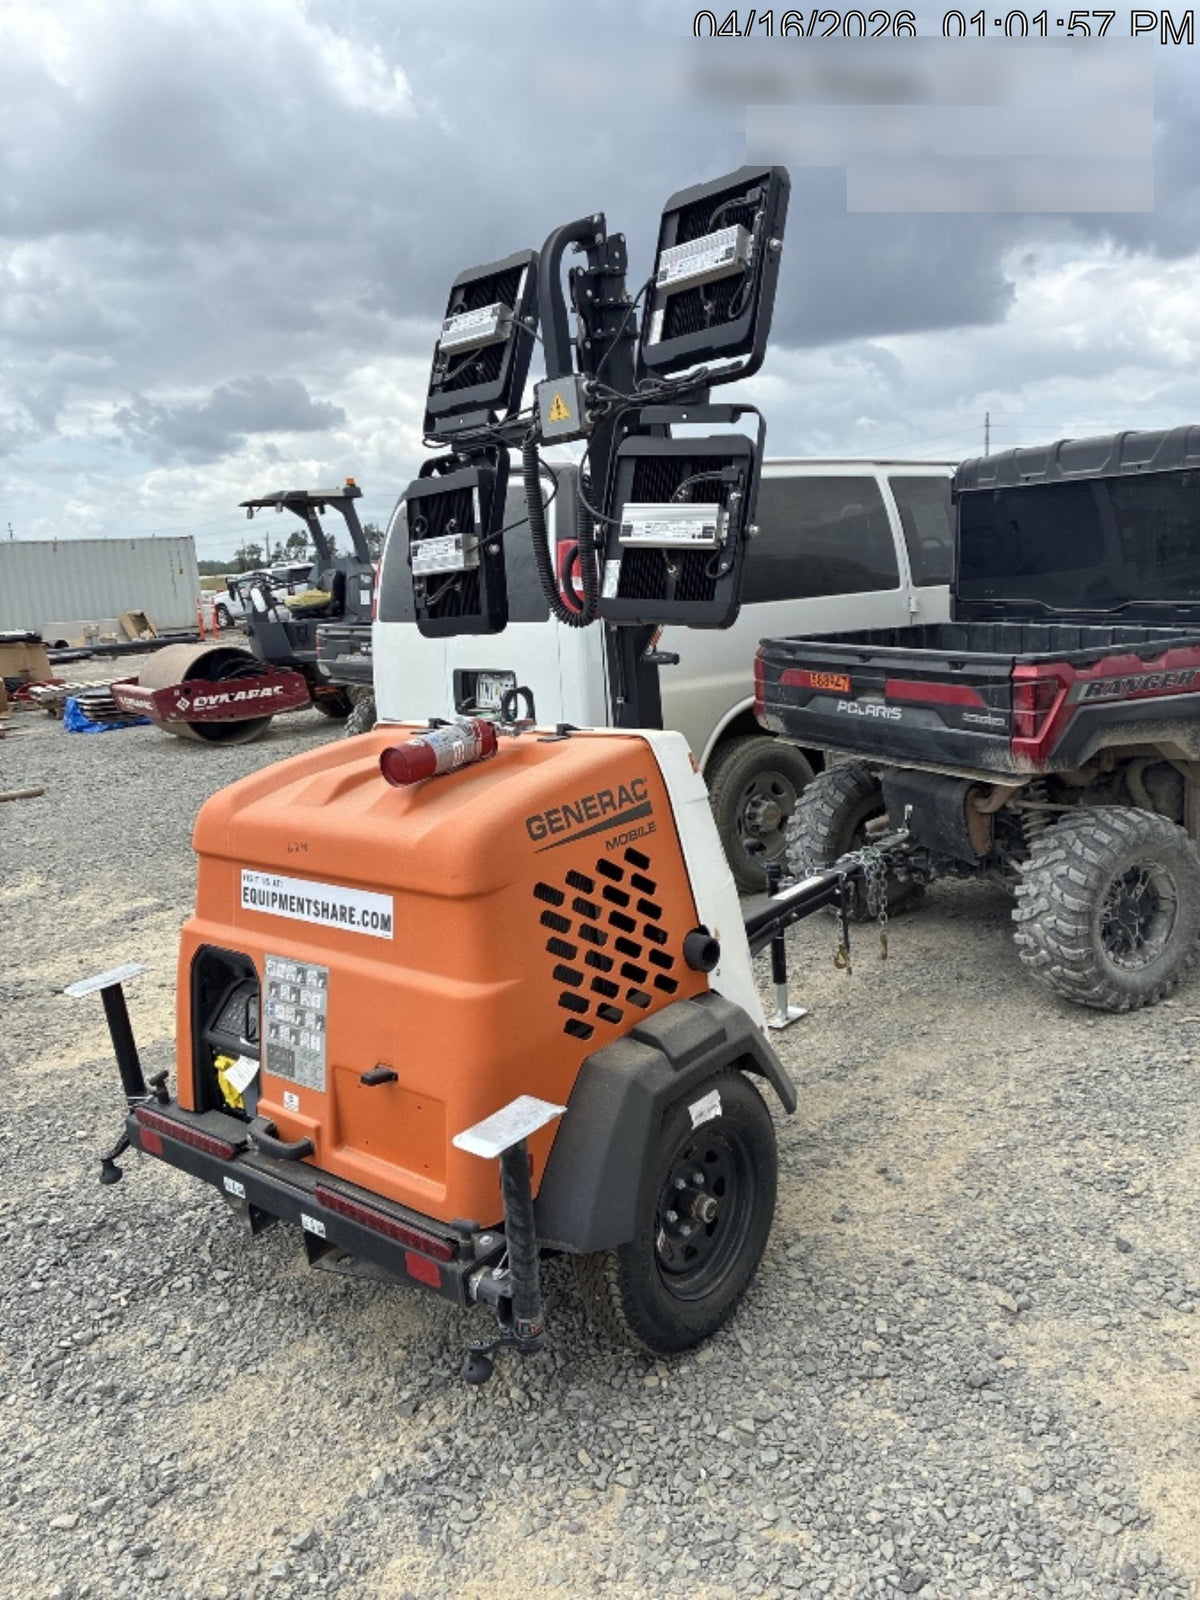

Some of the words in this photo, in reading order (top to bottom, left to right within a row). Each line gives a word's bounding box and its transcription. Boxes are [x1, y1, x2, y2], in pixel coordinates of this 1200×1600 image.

[1083, 670, 1195, 698] RANGER
[836, 700, 902, 720] POLARIS
[525, 777, 648, 842] GENERAC
[605, 821, 657, 851] MOBILE
[242, 886, 392, 932] EQUIPMENTSHARE.COM
